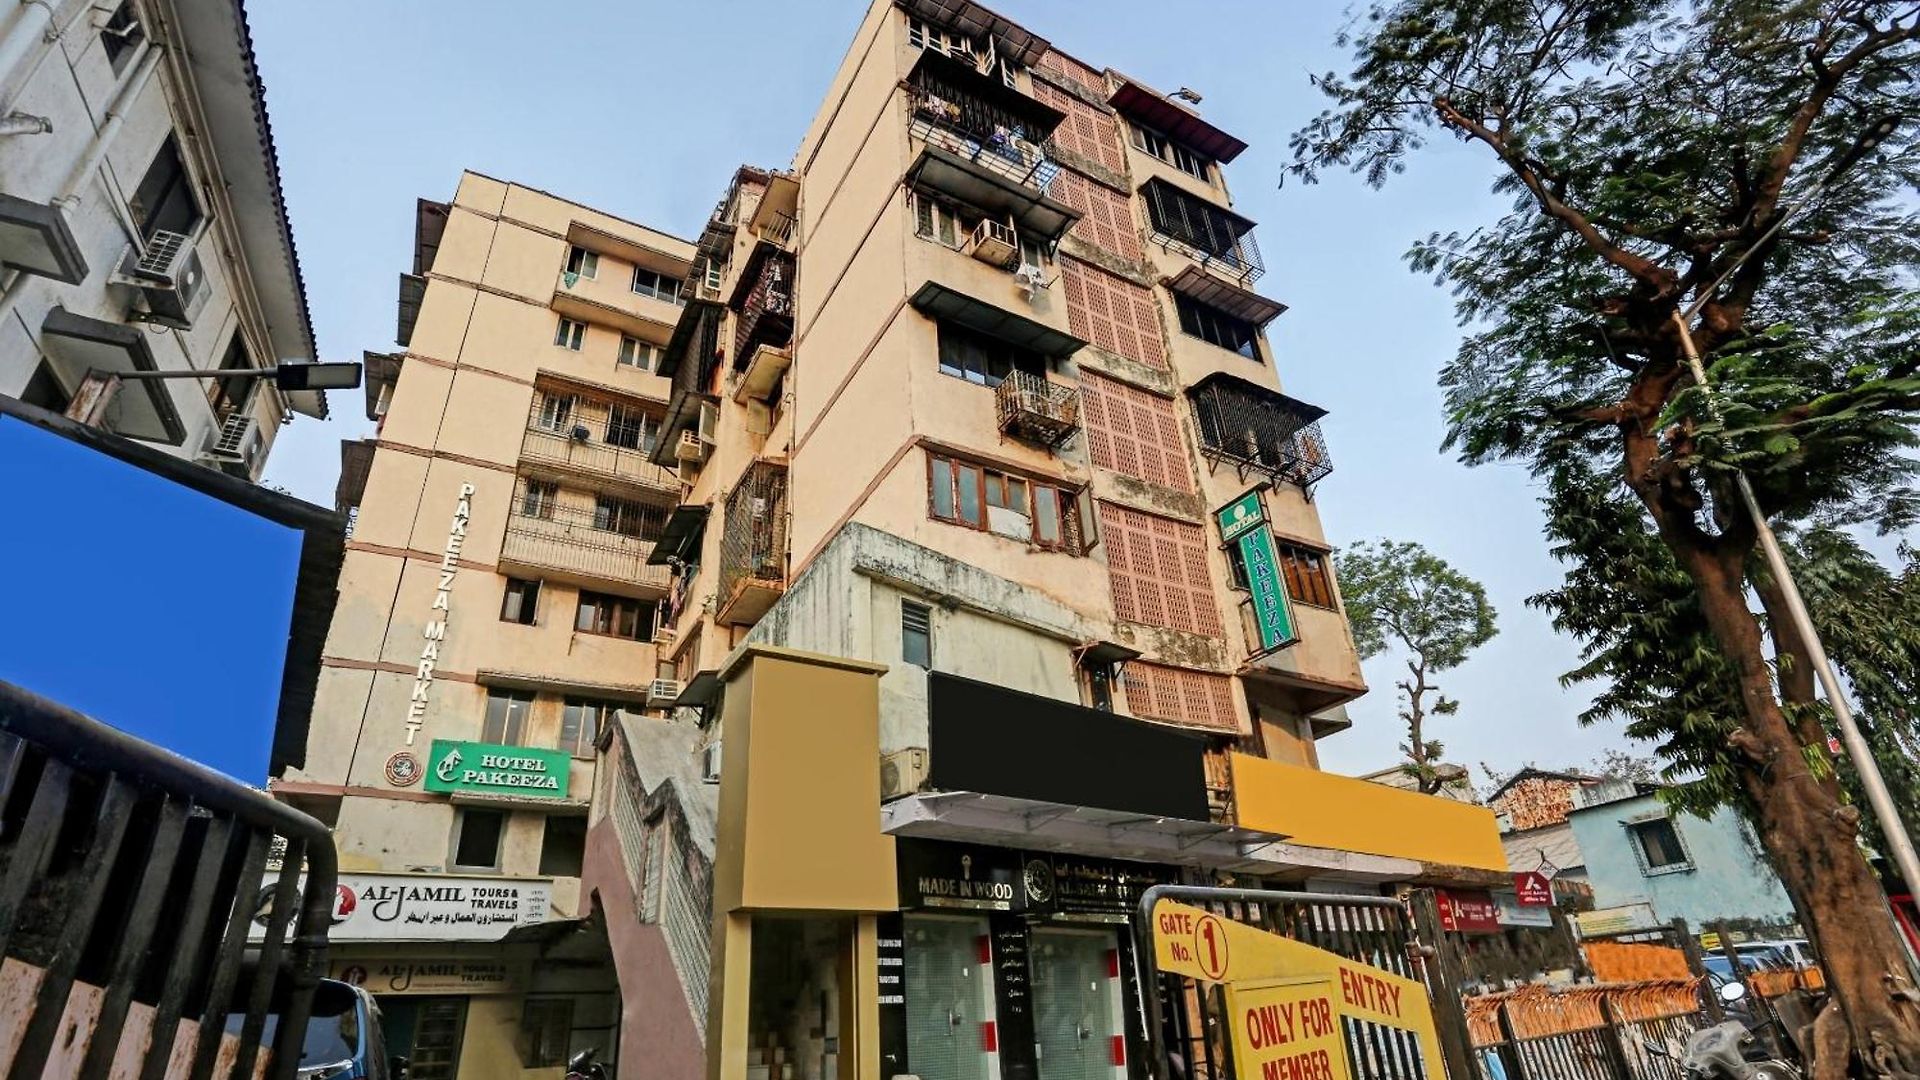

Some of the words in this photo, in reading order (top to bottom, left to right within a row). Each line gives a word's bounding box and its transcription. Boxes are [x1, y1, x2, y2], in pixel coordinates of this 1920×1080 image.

[432, 482, 475, 611] PAKEEZA
[1247, 530, 1285, 645] PAKEEZA
[406, 620, 445, 745] MARKET
[461, 769, 559, 789] PAKEEZA
[481, 754, 547, 772] HOTEL
[361, 886, 466, 922] AL-JAMIL
[472, 888, 510, 898] TOURS
[511, 889, 518, 898] &
[470, 901, 518, 910] TRAVELS
[919, 878, 957, 895] MADE
[960, 881, 972, 897] IN
[974, 882, 1013, 899] WOOD
[1159, 914, 1192, 936] GATE
[1204, 921, 1219, 973] 1
[1171, 942, 1193, 962] No.
[1339, 967, 1401, 1018] ENTRY
[1246, 1002, 1296, 1051] ONLY
[1300, 998, 1334, 1039] FOR
